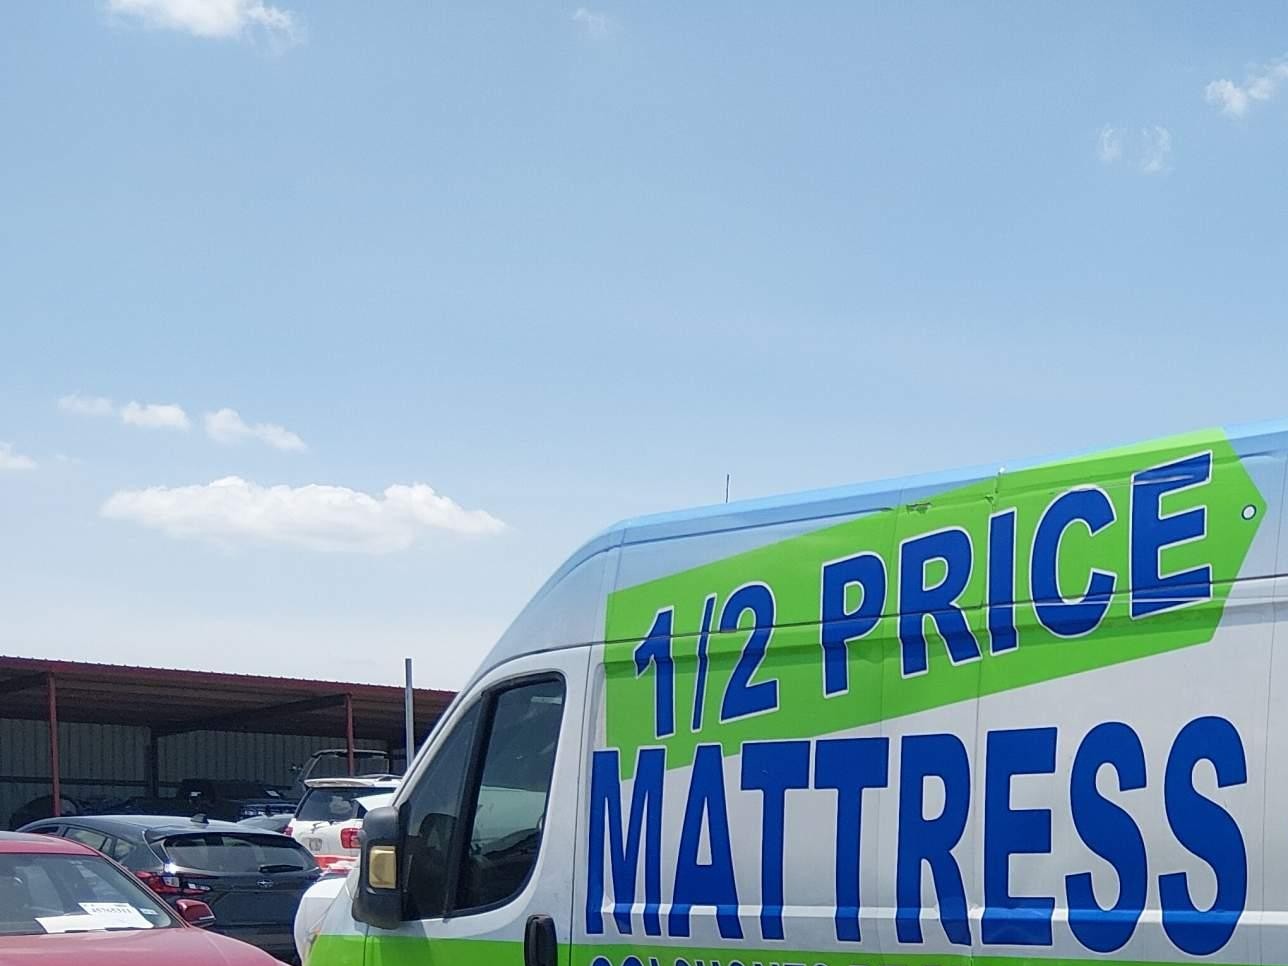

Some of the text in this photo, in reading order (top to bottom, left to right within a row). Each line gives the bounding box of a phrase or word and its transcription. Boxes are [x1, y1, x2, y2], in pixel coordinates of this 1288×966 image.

[633, 451, 1213, 740] 1/2 PRICE
[584, 715, 1249, 957] MATTRESS
